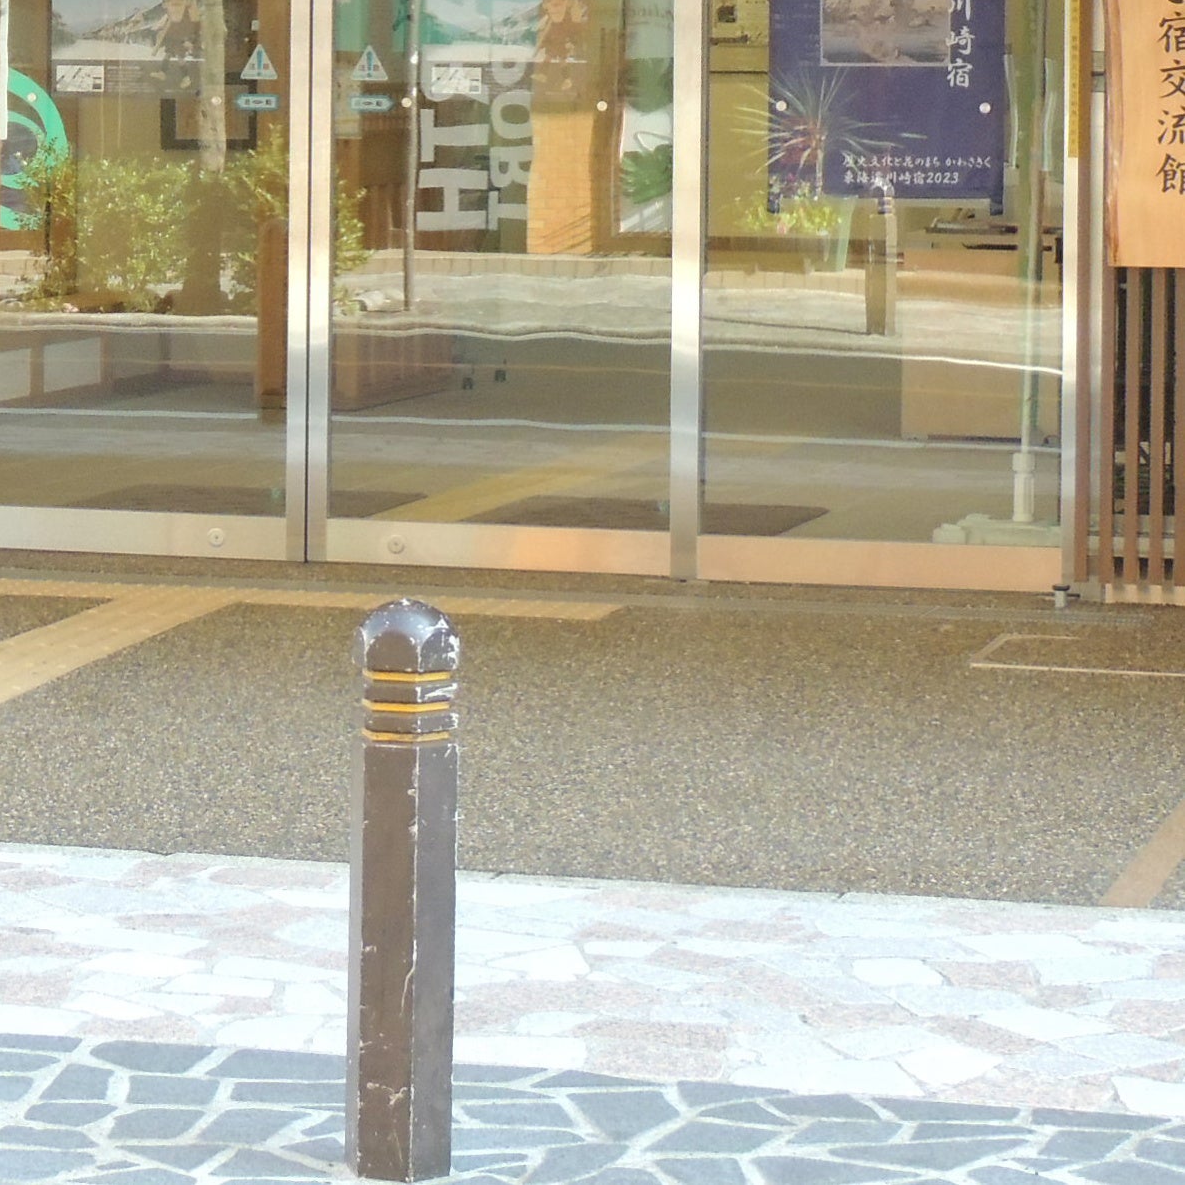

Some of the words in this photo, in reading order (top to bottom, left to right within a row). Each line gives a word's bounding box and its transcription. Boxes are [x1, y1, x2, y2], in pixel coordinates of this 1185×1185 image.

[945, 156, 991, 168] かわさきく
